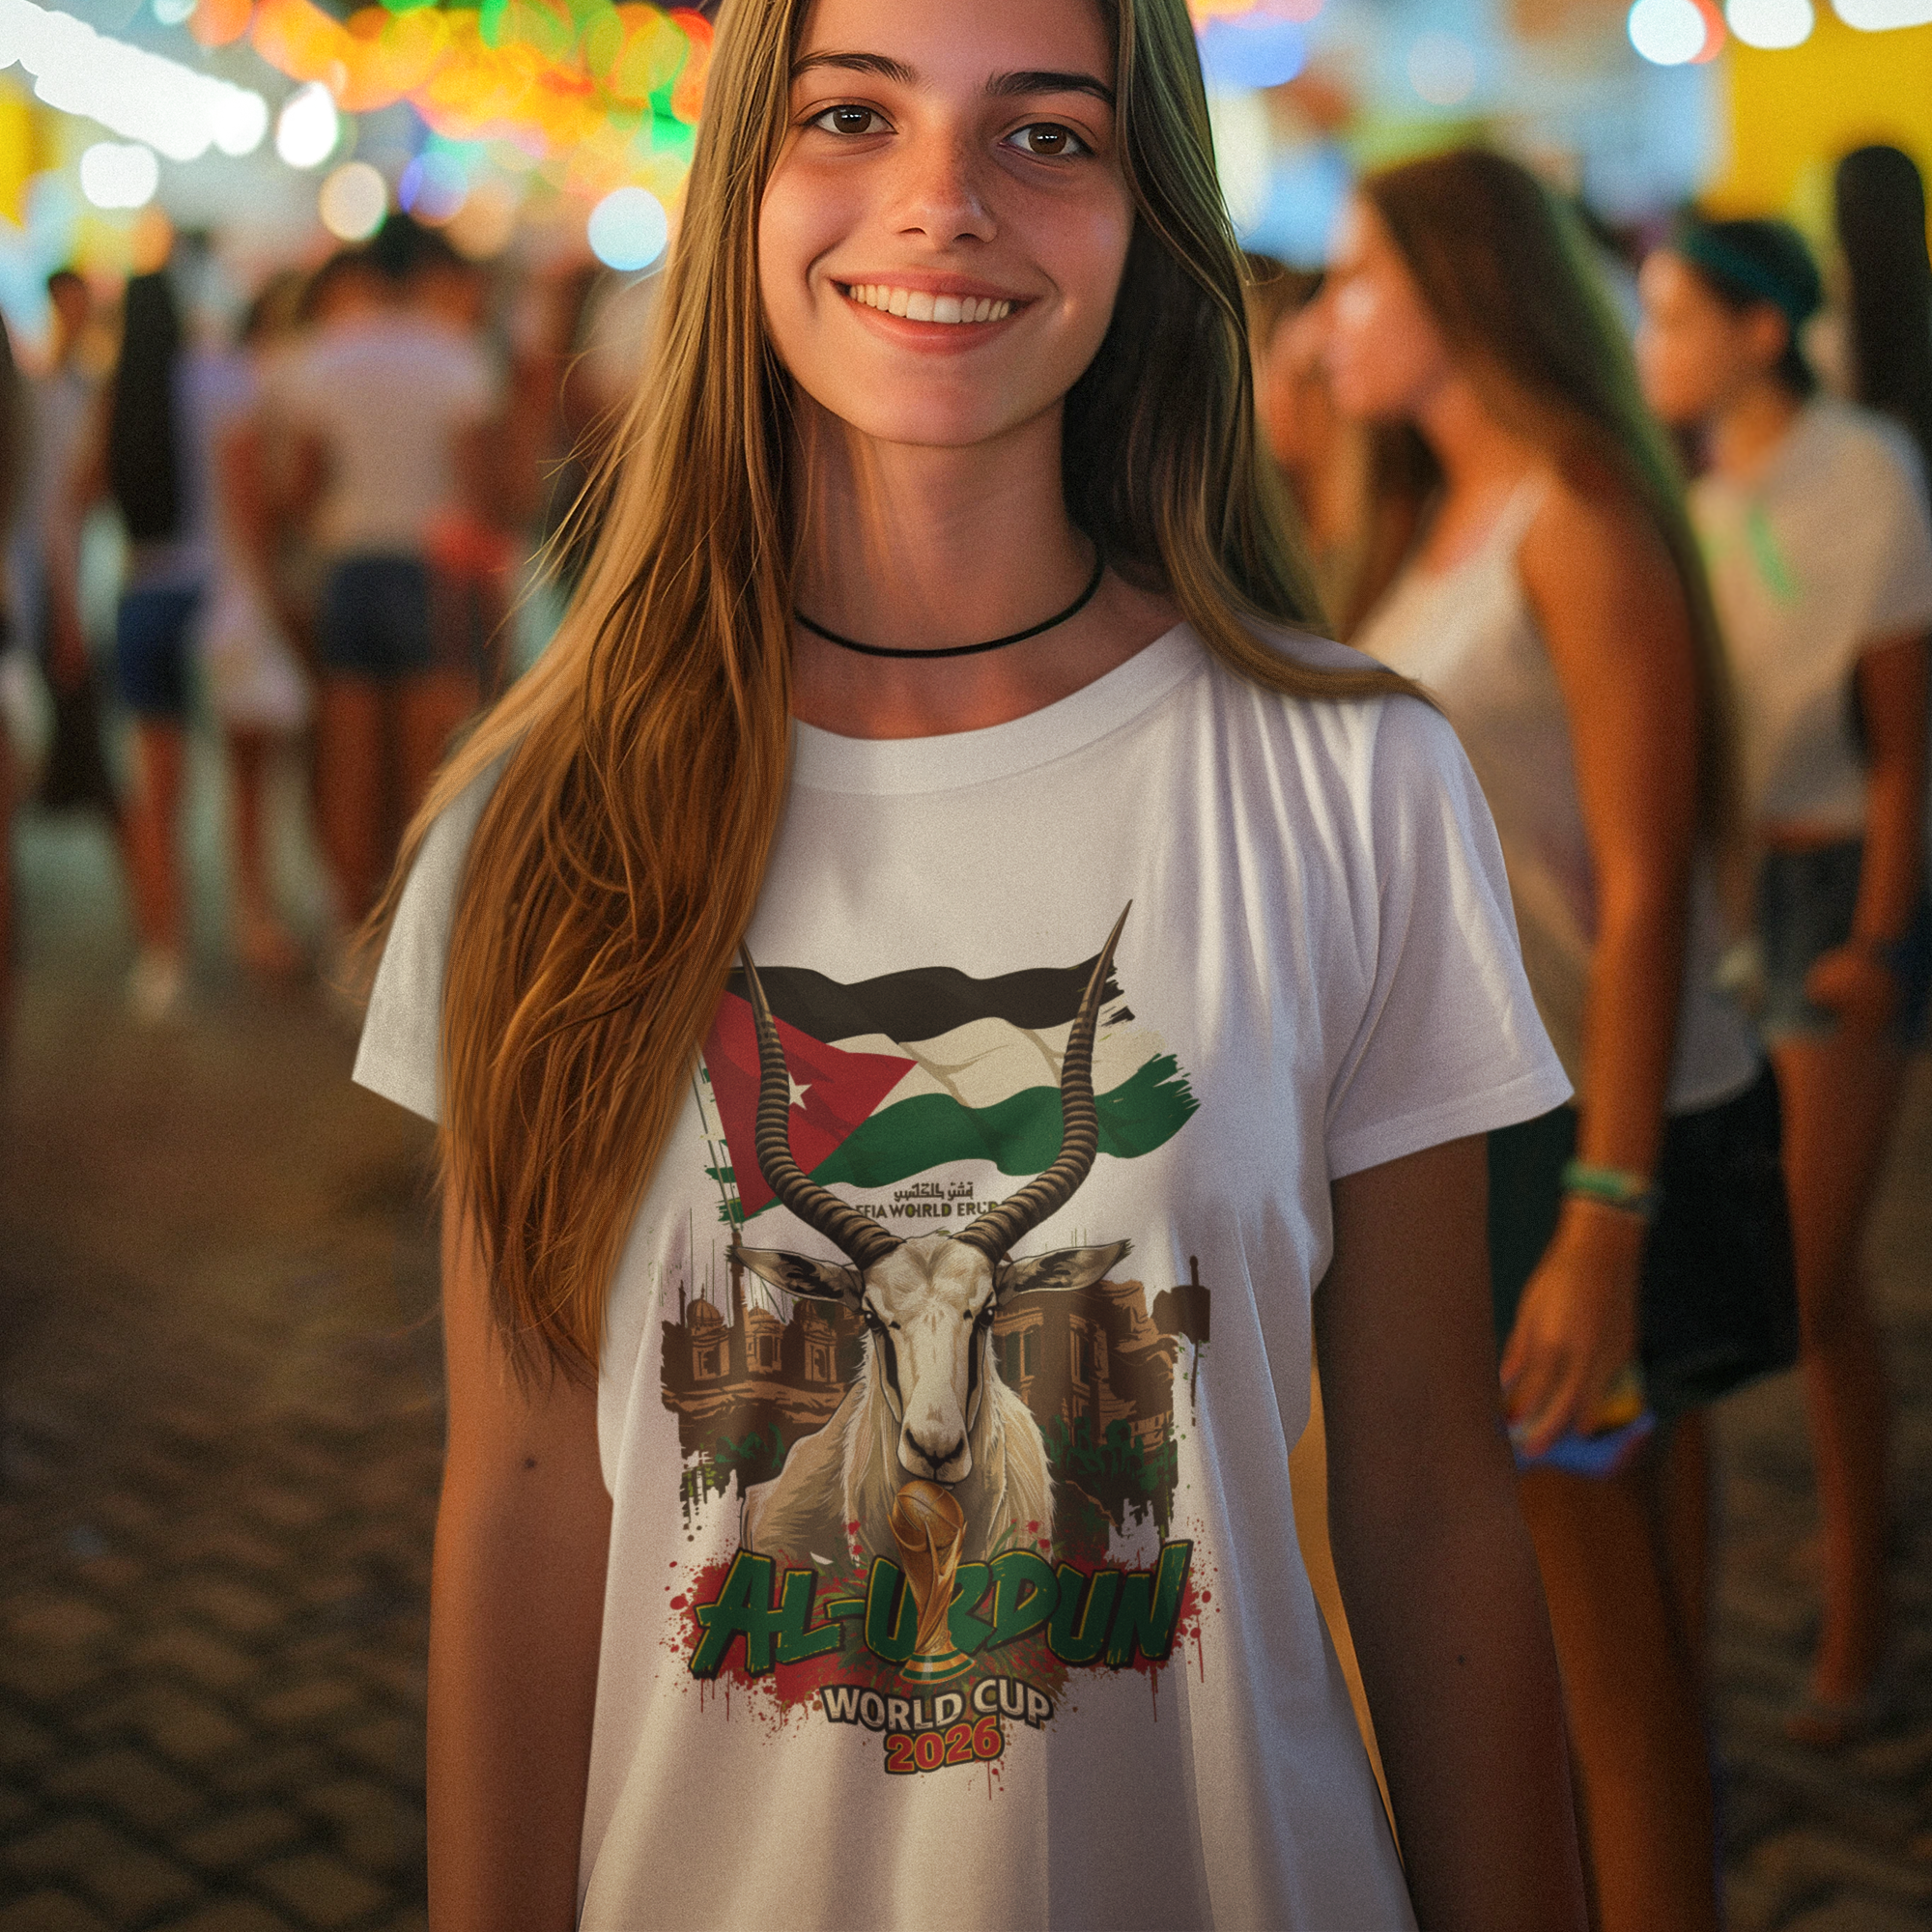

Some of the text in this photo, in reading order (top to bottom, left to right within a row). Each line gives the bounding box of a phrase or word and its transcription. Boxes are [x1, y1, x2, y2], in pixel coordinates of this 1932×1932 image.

[690, 1539, 1194, 1680] AL-URDUN
[820, 1677, 1054, 1731] WORLD CUP
[884, 1715, 1005, 1775] 2026
